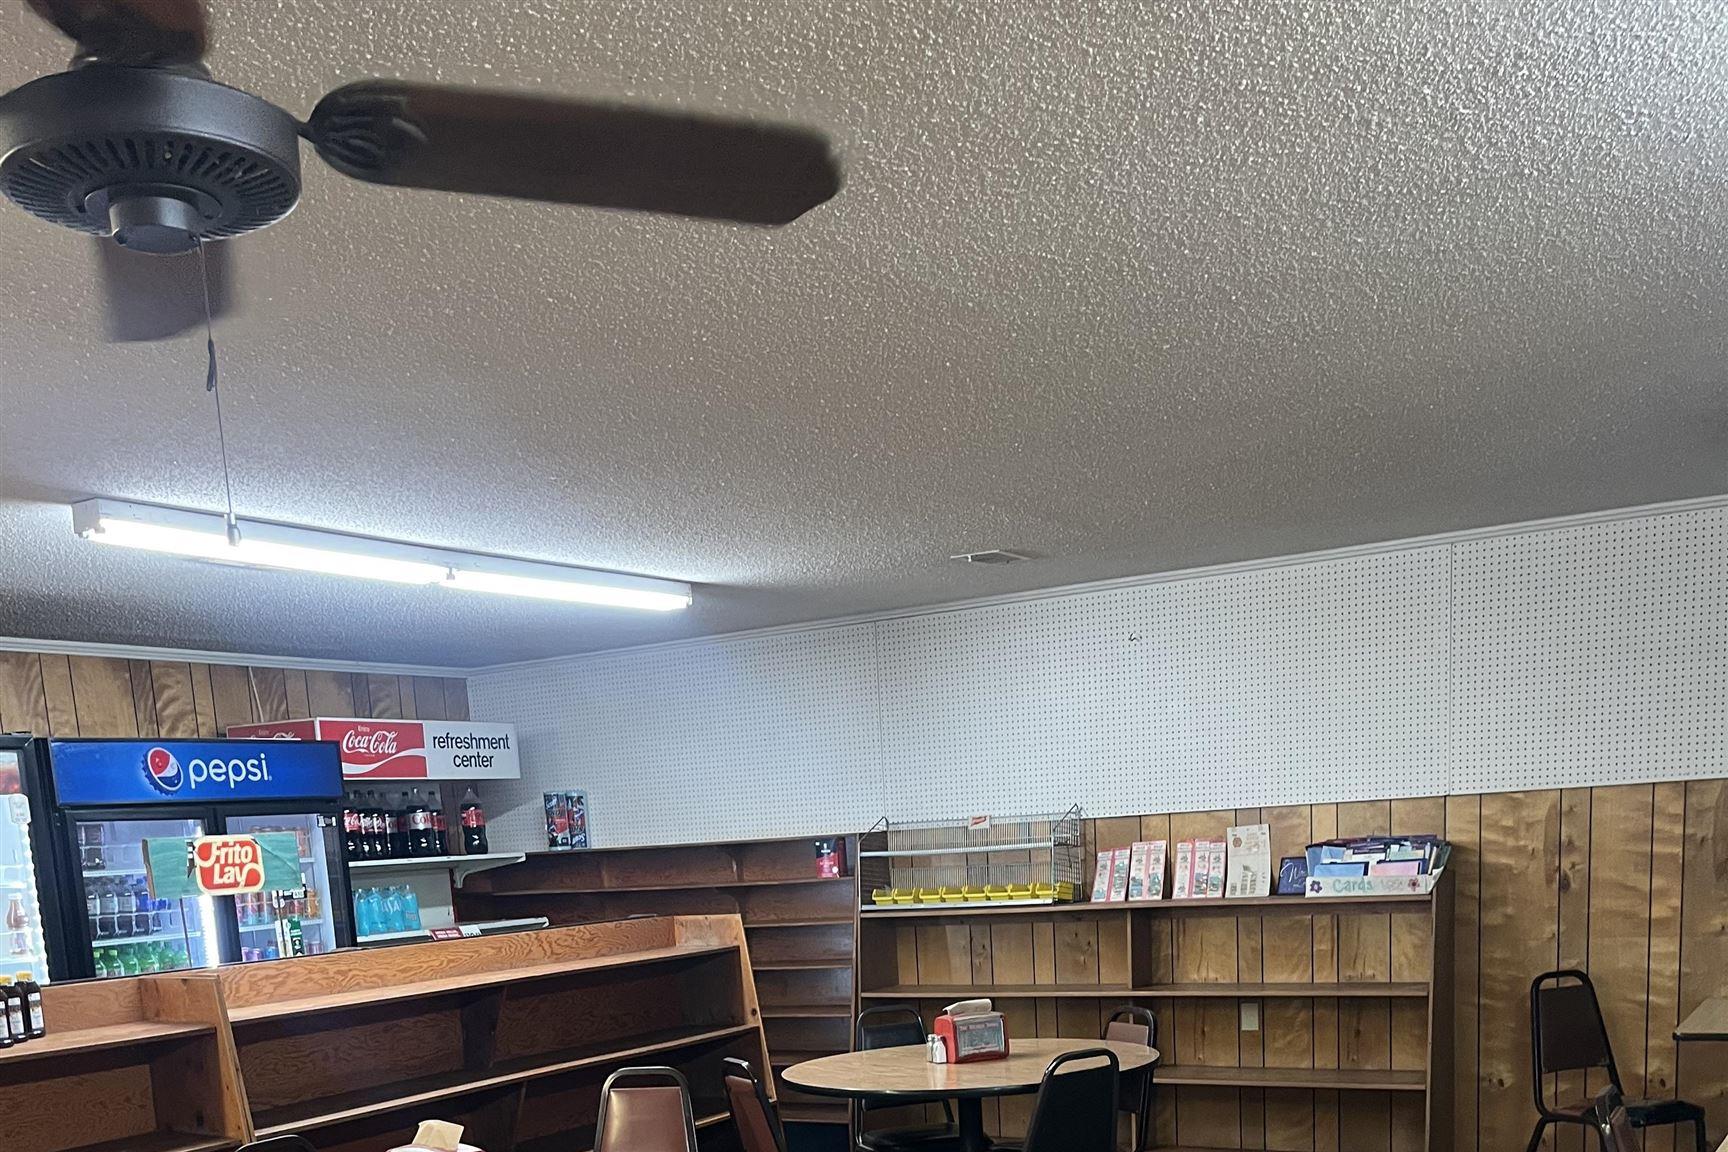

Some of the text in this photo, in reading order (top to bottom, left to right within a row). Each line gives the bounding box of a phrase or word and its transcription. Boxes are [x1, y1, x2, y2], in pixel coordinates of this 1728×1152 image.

[342, 730, 398, 754] Coca-Cola
[432, 732, 510, 750] refreshment
[188, 752, 269, 789] pepsi
[453, 752, 494, 768] center
[207, 840, 253, 866] Frito
[213, 863, 250, 888] Lay
[1332, 877, 1373, 894] Cards
